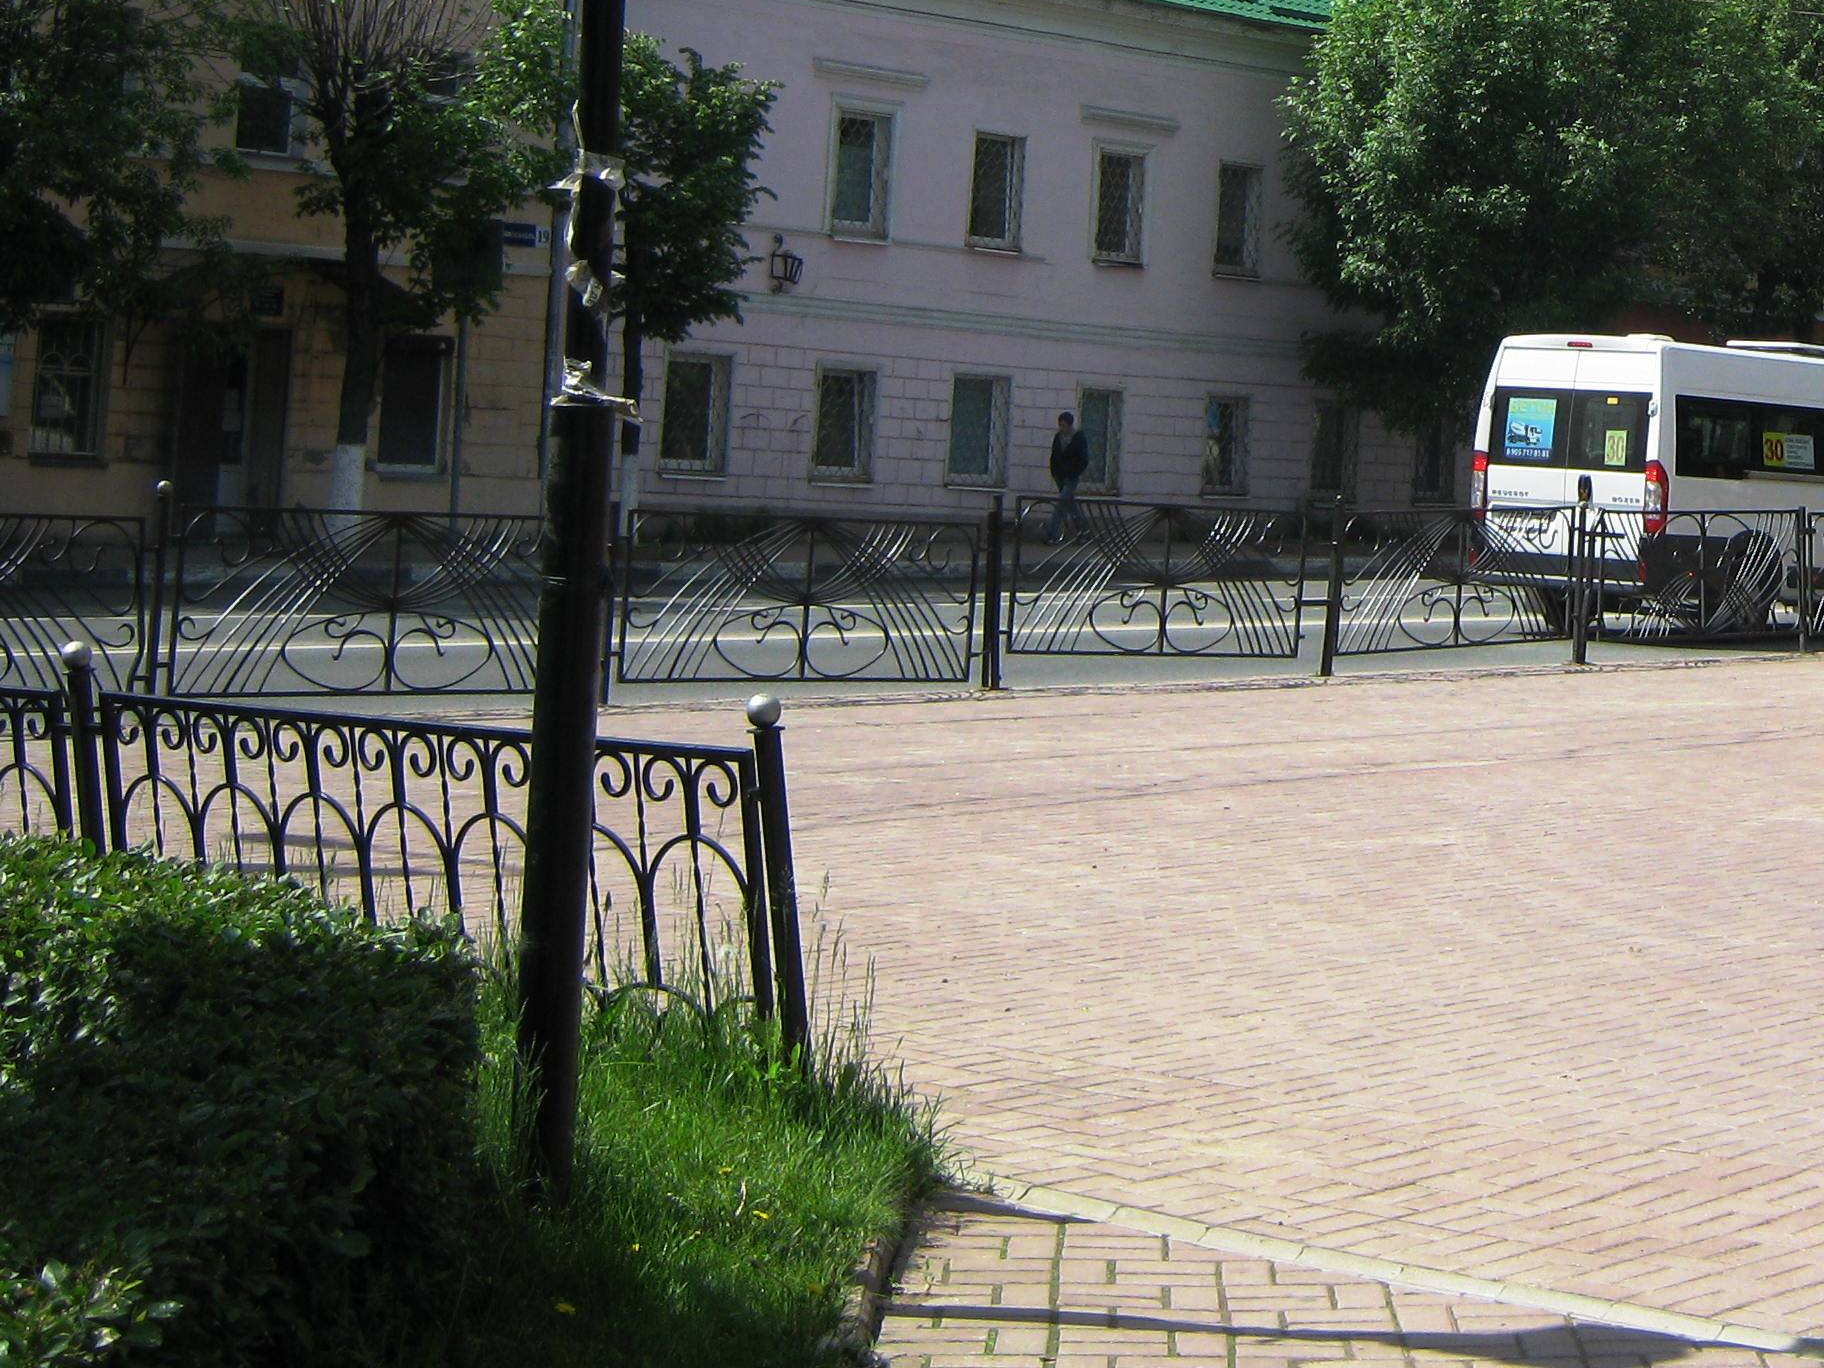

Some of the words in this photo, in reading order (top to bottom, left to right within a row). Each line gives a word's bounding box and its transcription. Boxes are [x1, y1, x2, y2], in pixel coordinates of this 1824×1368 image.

[537, 230, 550, 243] 19
[1606, 435, 1625, 462] 30
[1765, 439, 1784, 461] 30
